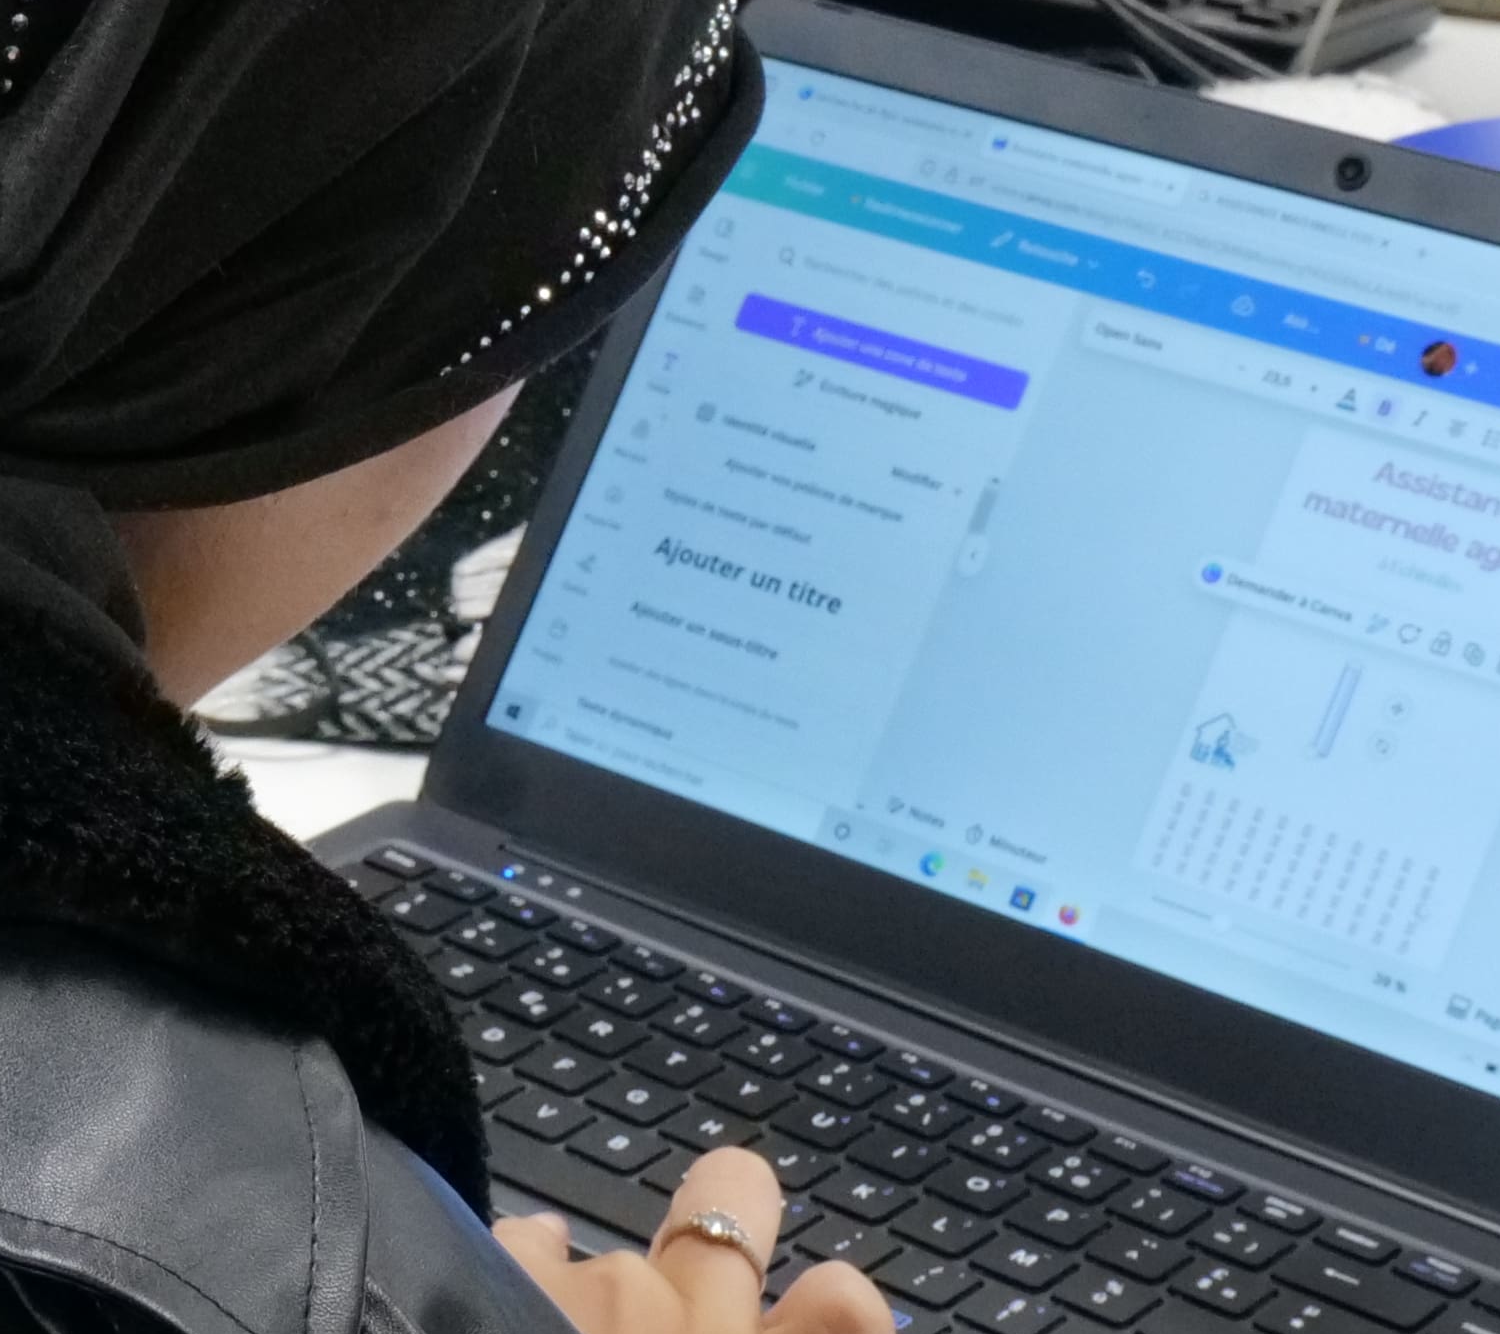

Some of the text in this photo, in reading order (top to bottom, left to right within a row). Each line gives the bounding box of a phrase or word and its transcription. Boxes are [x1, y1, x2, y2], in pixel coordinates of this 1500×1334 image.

[1092, 321, 1165, 351] Open Sans
[1301, 488, 1463, 554] maternelle
[650, 534, 847, 616] Ajouter un titre
[1226, 569, 1296, 608] Demander
[1310, 593, 1354, 624] Canva
[627, 599, 781, 662] Ajouter un sous-titre
[906, 805, 947, 829] Notes
[986, 833, 1049, 866] Minuteur
